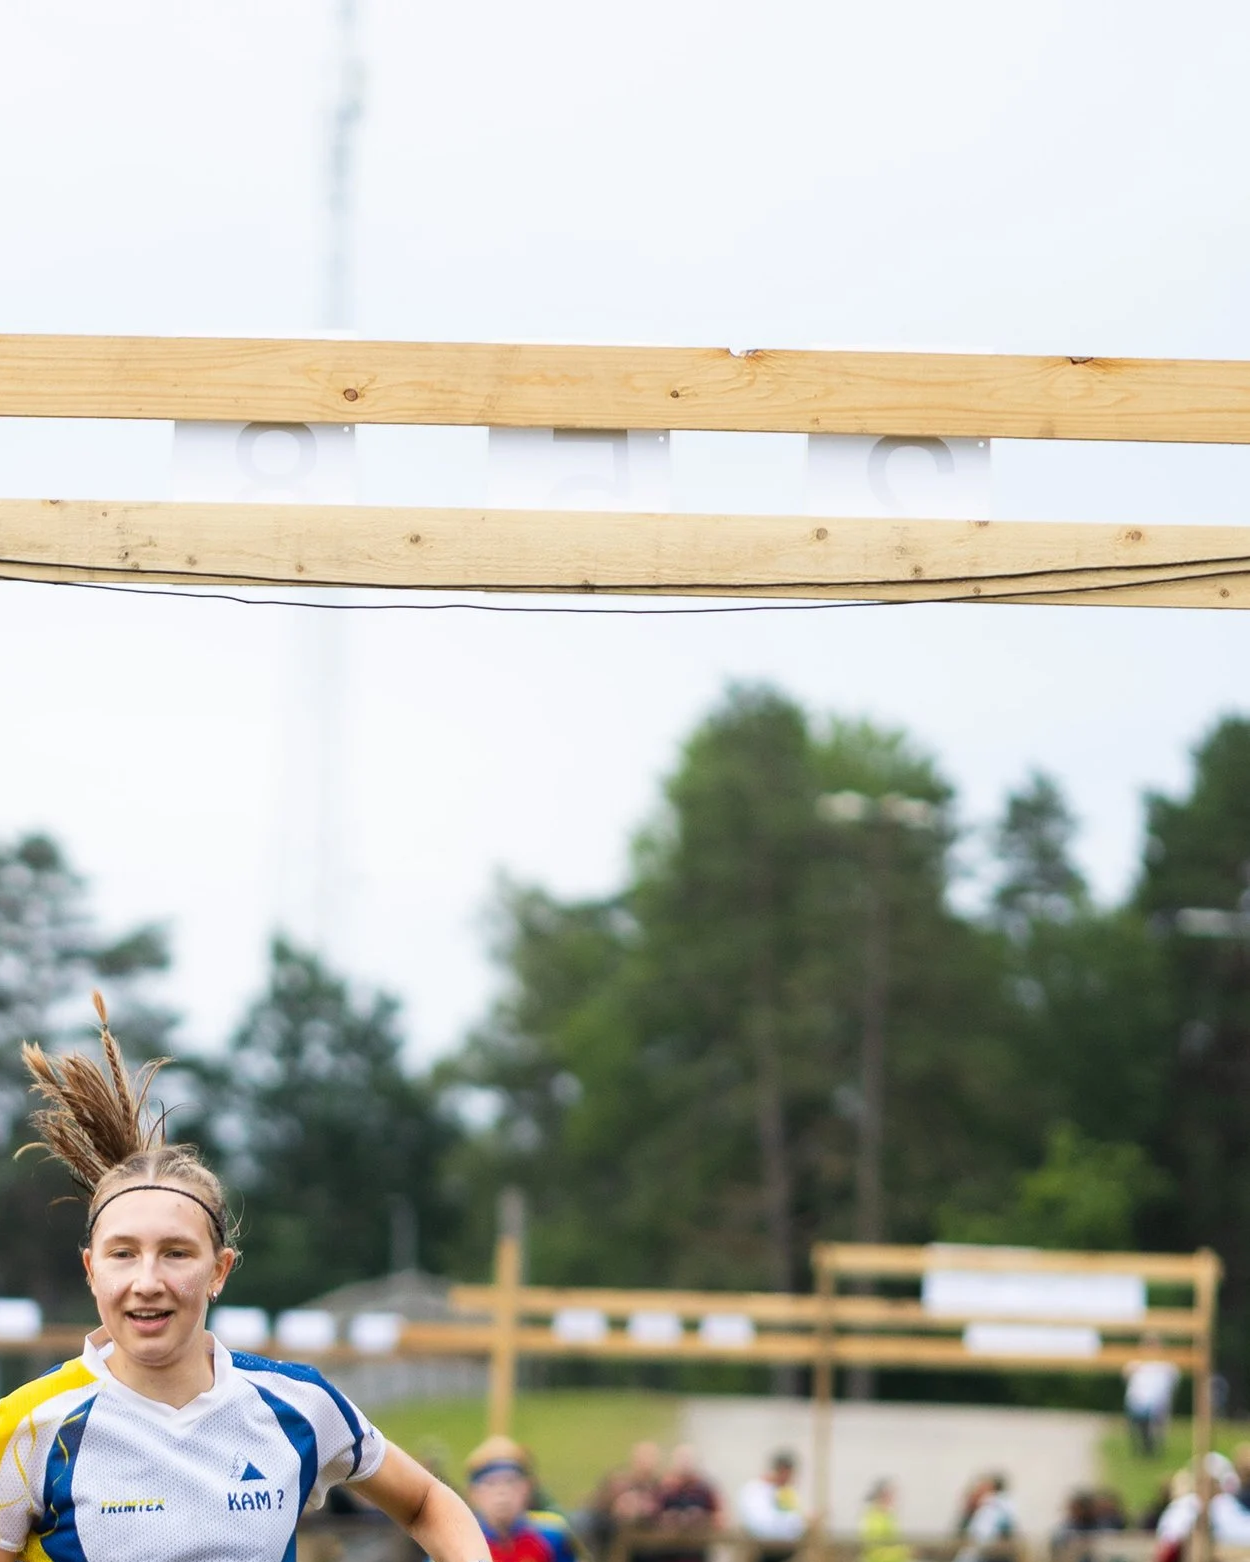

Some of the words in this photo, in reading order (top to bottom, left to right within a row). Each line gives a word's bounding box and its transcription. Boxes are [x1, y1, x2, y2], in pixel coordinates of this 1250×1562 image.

[100, 1498, 165, 1514] TRIMTEX
[227, 1490, 272, 1511] KAM
[276, 1489, 285, 1511] ?
